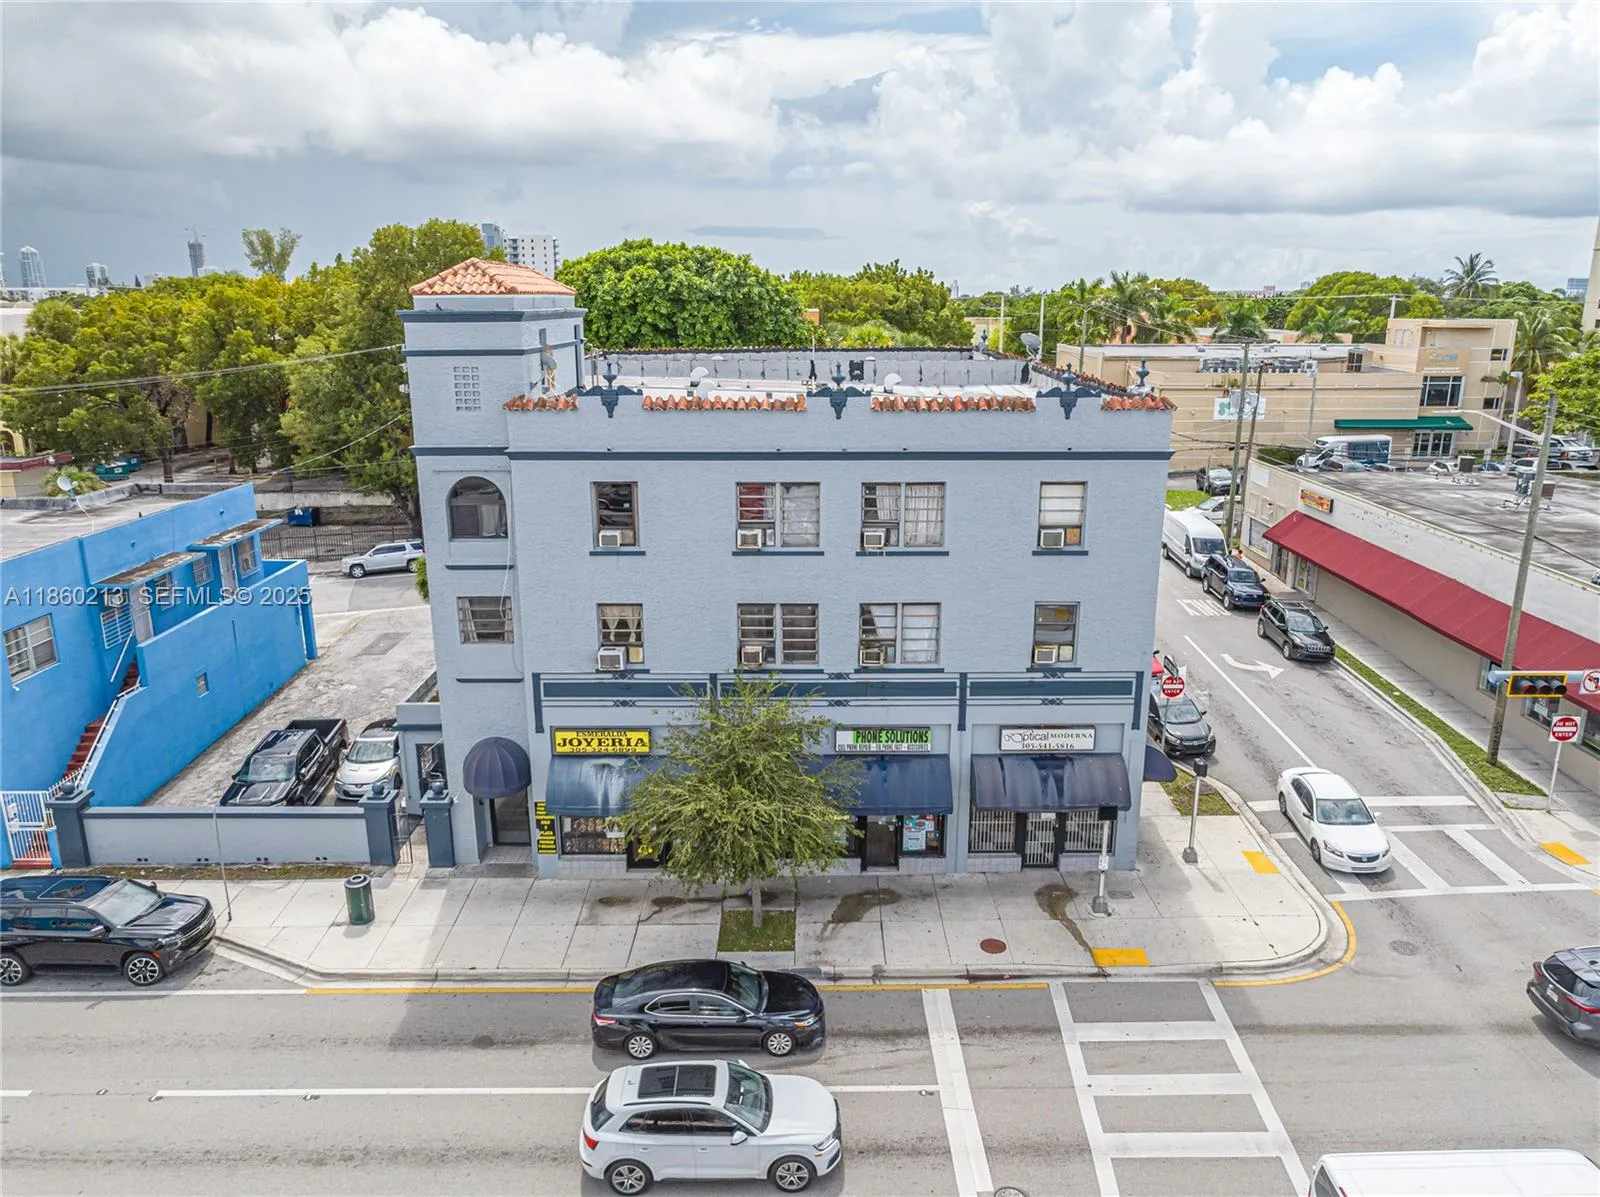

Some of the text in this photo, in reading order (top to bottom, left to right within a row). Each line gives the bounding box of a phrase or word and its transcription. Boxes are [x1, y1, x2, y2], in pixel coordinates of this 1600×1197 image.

[557, 737, 646, 747] JOYERIA
[856, 730, 929, 743] PHONE SOLUTIONS
